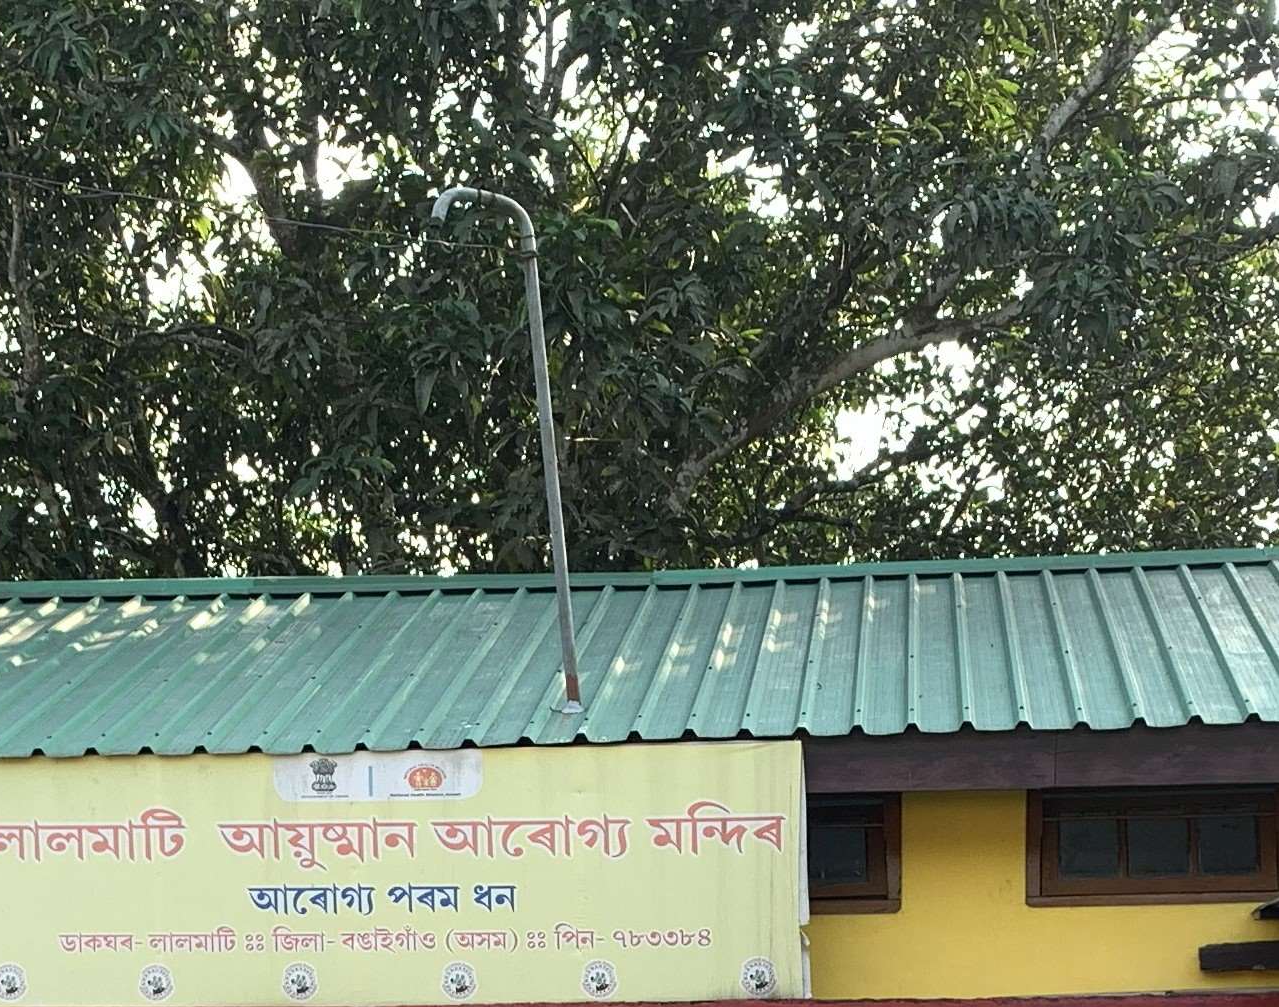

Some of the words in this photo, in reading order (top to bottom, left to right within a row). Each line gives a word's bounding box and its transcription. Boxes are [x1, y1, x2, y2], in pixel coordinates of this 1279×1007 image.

[218, 818, 417, 870] আয়ুষ্মান
[431, 814, 631, 858] আৰোগ্য
[646, 801, 785, 854] মন্দিৰ
[248, 883, 375, 915] আৰোগ্য
[387, 886, 459, 913] পৰম
[474, 886, 516, 912] ধন
[59, 932, 142, 952] ডাকঘৰ-
[148, 927, 236, 952] লালমাটি
[272, 926, 334, 952] জিলা-
[341, 925, 436, 952] বঙাইগাঁও
[446, 929, 518, 952] (অসম)
[555, 923, 604, 951] পিন-
[613, 928, 711, 947] ৭৮৩৩৮৪
